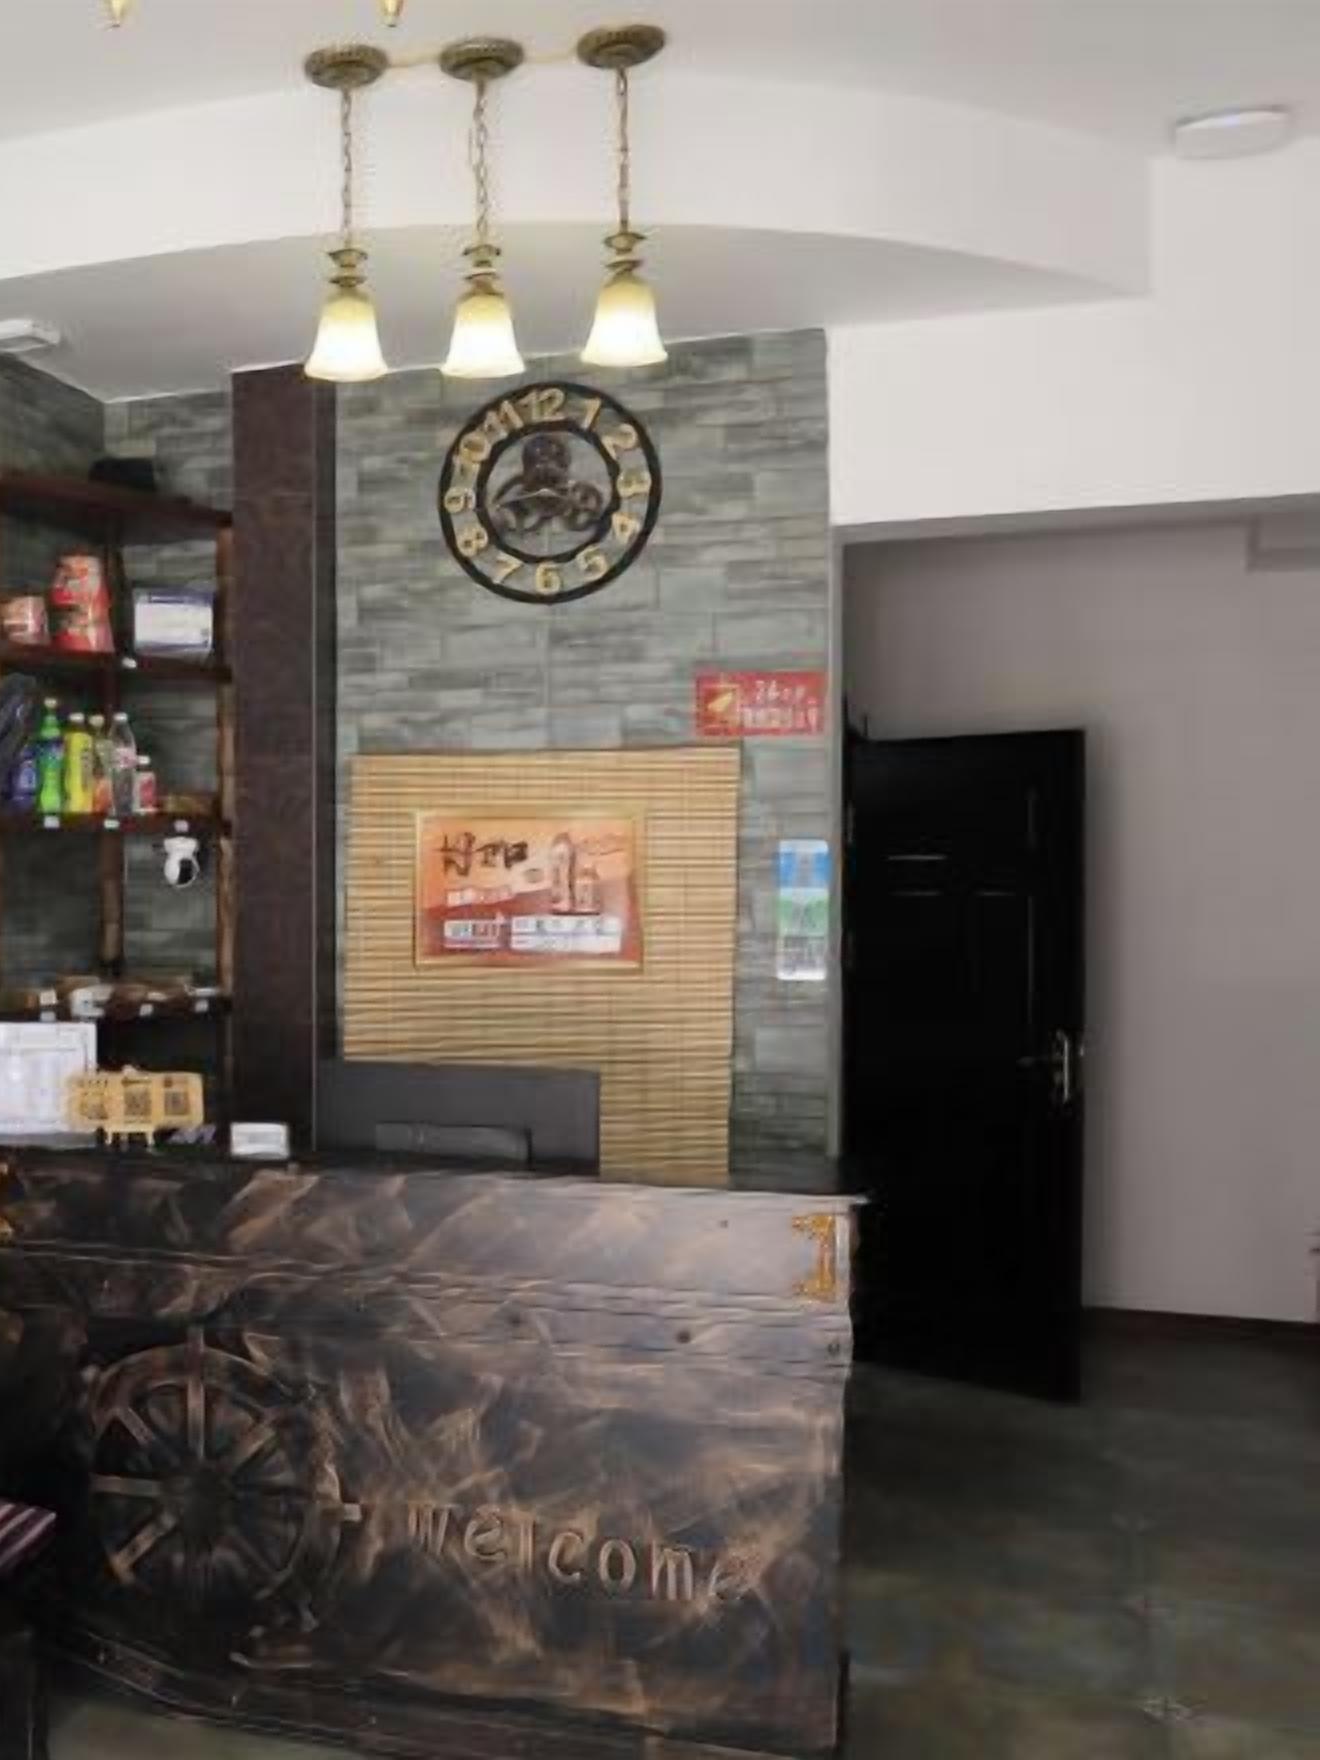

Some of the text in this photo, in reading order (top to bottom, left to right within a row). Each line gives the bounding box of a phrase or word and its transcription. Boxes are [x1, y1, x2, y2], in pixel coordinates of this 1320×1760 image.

[520, 388, 565, 421] 12
[601, 423, 639, 459] 2
[444, 487, 477, 514] 9
[456, 526, 489, 556] 8
[491, 555, 523, 585] 7
[535, 562, 562, 595] 6
[576, 545, 608, 580] 5
